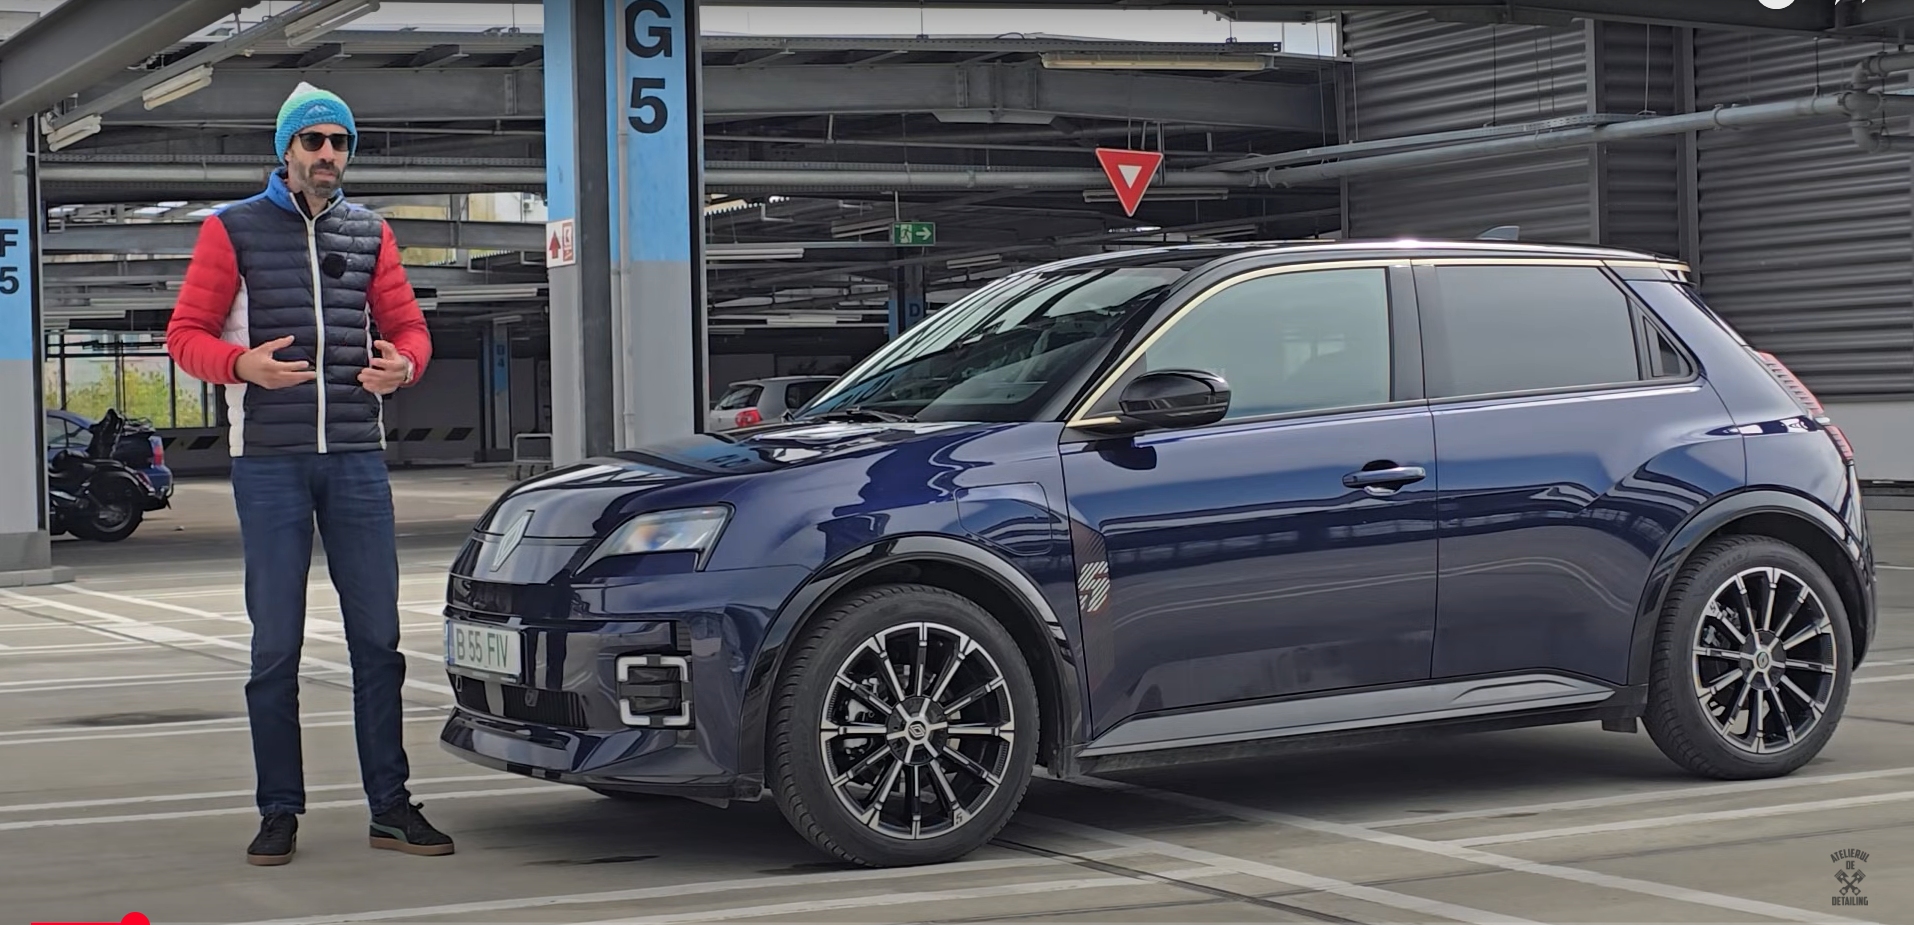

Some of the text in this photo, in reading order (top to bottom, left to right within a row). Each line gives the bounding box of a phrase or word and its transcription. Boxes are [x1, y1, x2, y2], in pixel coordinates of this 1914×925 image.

[625, 0, 672, 58] G
[628, 77, 668, 134] 5
[0, 229, 19, 257] F
[0, 266, 20, 295] 5
[909, 303, 921, 317] D
[456, 628, 509, 668] B 55 FIV
